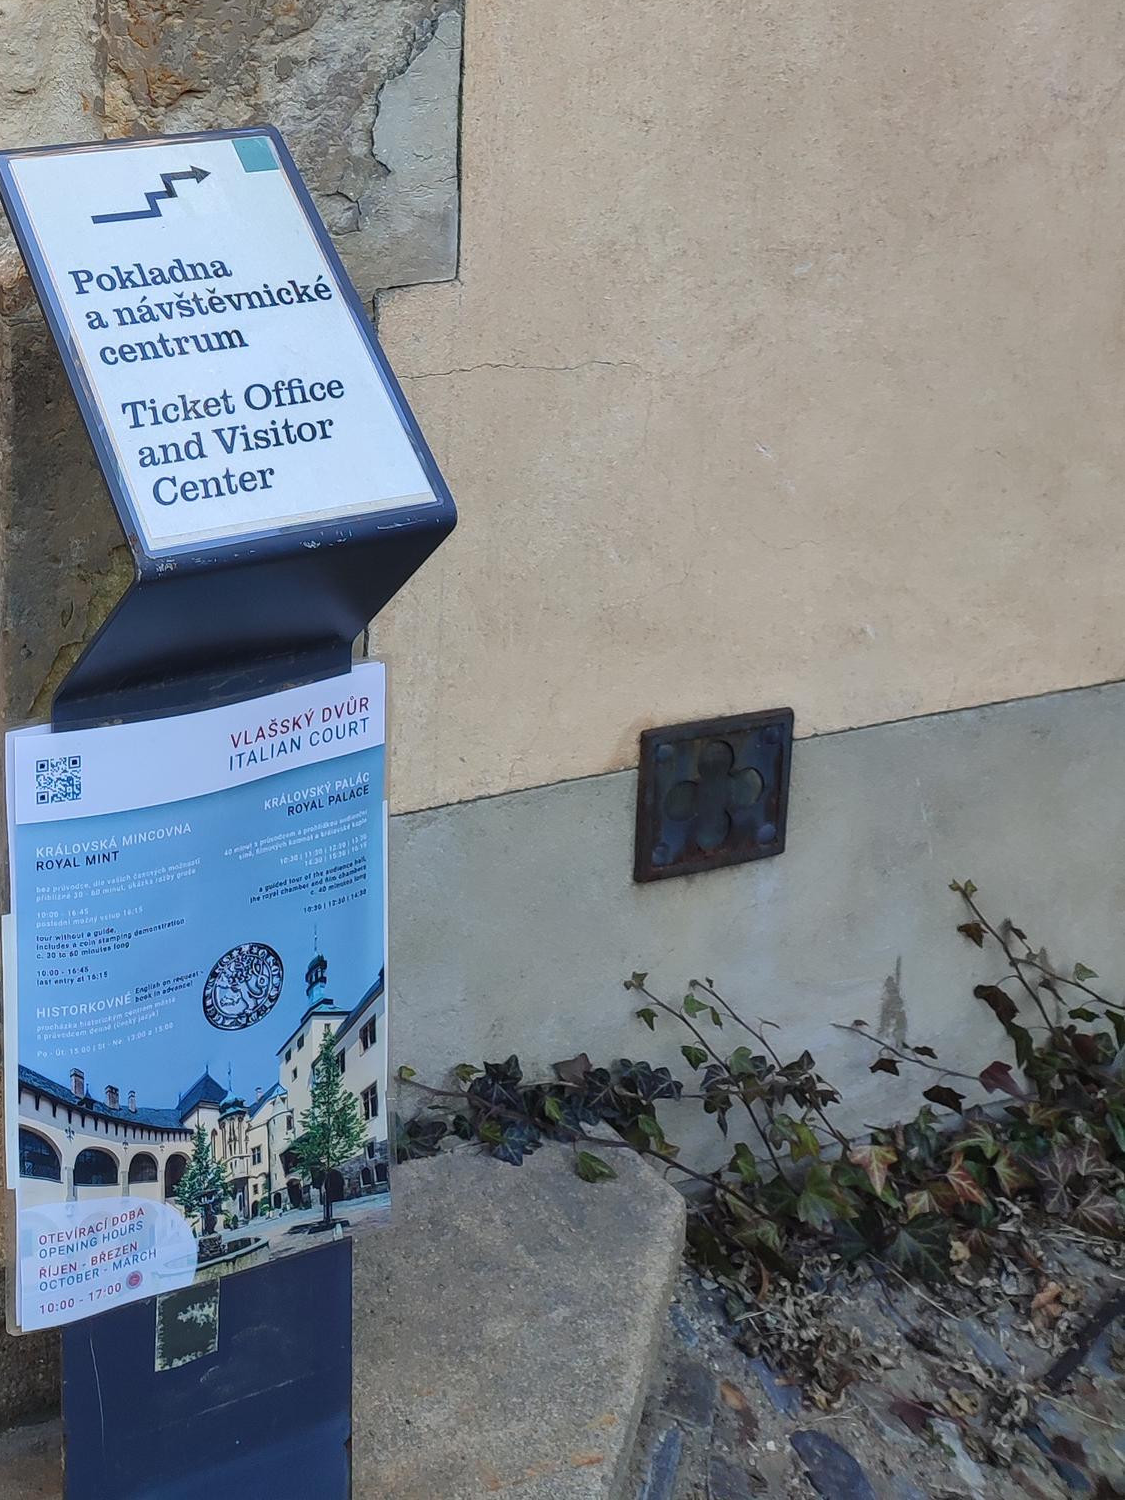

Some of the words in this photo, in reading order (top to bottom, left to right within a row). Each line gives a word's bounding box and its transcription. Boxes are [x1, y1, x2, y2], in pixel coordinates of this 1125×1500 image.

[69, 257, 232, 295] Pokladna
[86, 309, 108, 329] a
[114, 275, 332, 327] návštěvnické
[99, 327, 248, 365] centrum
[122, 387, 235, 429] Ticket
[245, 378, 344, 411] Office
[138, 432, 207, 467] and
[213, 416, 334, 454] Visitor
[153, 467, 275, 506] Center
[231, 708, 314, 748] VLAŠSKÝ
[322, 696, 369, 723] DVŮR
[229, 736, 301, 771] ITALIAN
[310, 717, 369, 746] COURT
[264, 782, 332, 810] KRÁLOVSKÝ
[335, 772, 369, 791] PALÁC
[288, 799, 324, 816] ROYAL
[329, 785, 369, 806] PALACE
[36, 836, 117, 858] KRÁLOVSKÁ
[122, 823, 191, 846] MINCOVNA
[36, 858, 80, 871] ROYAL
[86, 851, 119, 865] MINT
[37, 991, 132, 1019] HISTORKOVNÉ
[39, 1217, 107, 1245] OTEVÍRACÍ
[112, 1207, 145, 1226] DOBA
[39, 1237, 97, 1259] OPENING
[103, 1221, 143, 1243] HOURS
[39, 1262, 77, 1279] ŘÍJEN
[91, 1242, 138, 1266] BŘEZEN
[40, 1268, 99, 1291] OCTOBER
[113, 1249, 156, 1271] MARCH
[40, 1298, 74, 1314] 10:00
[89, 1283, 121, 1301] 17:00
